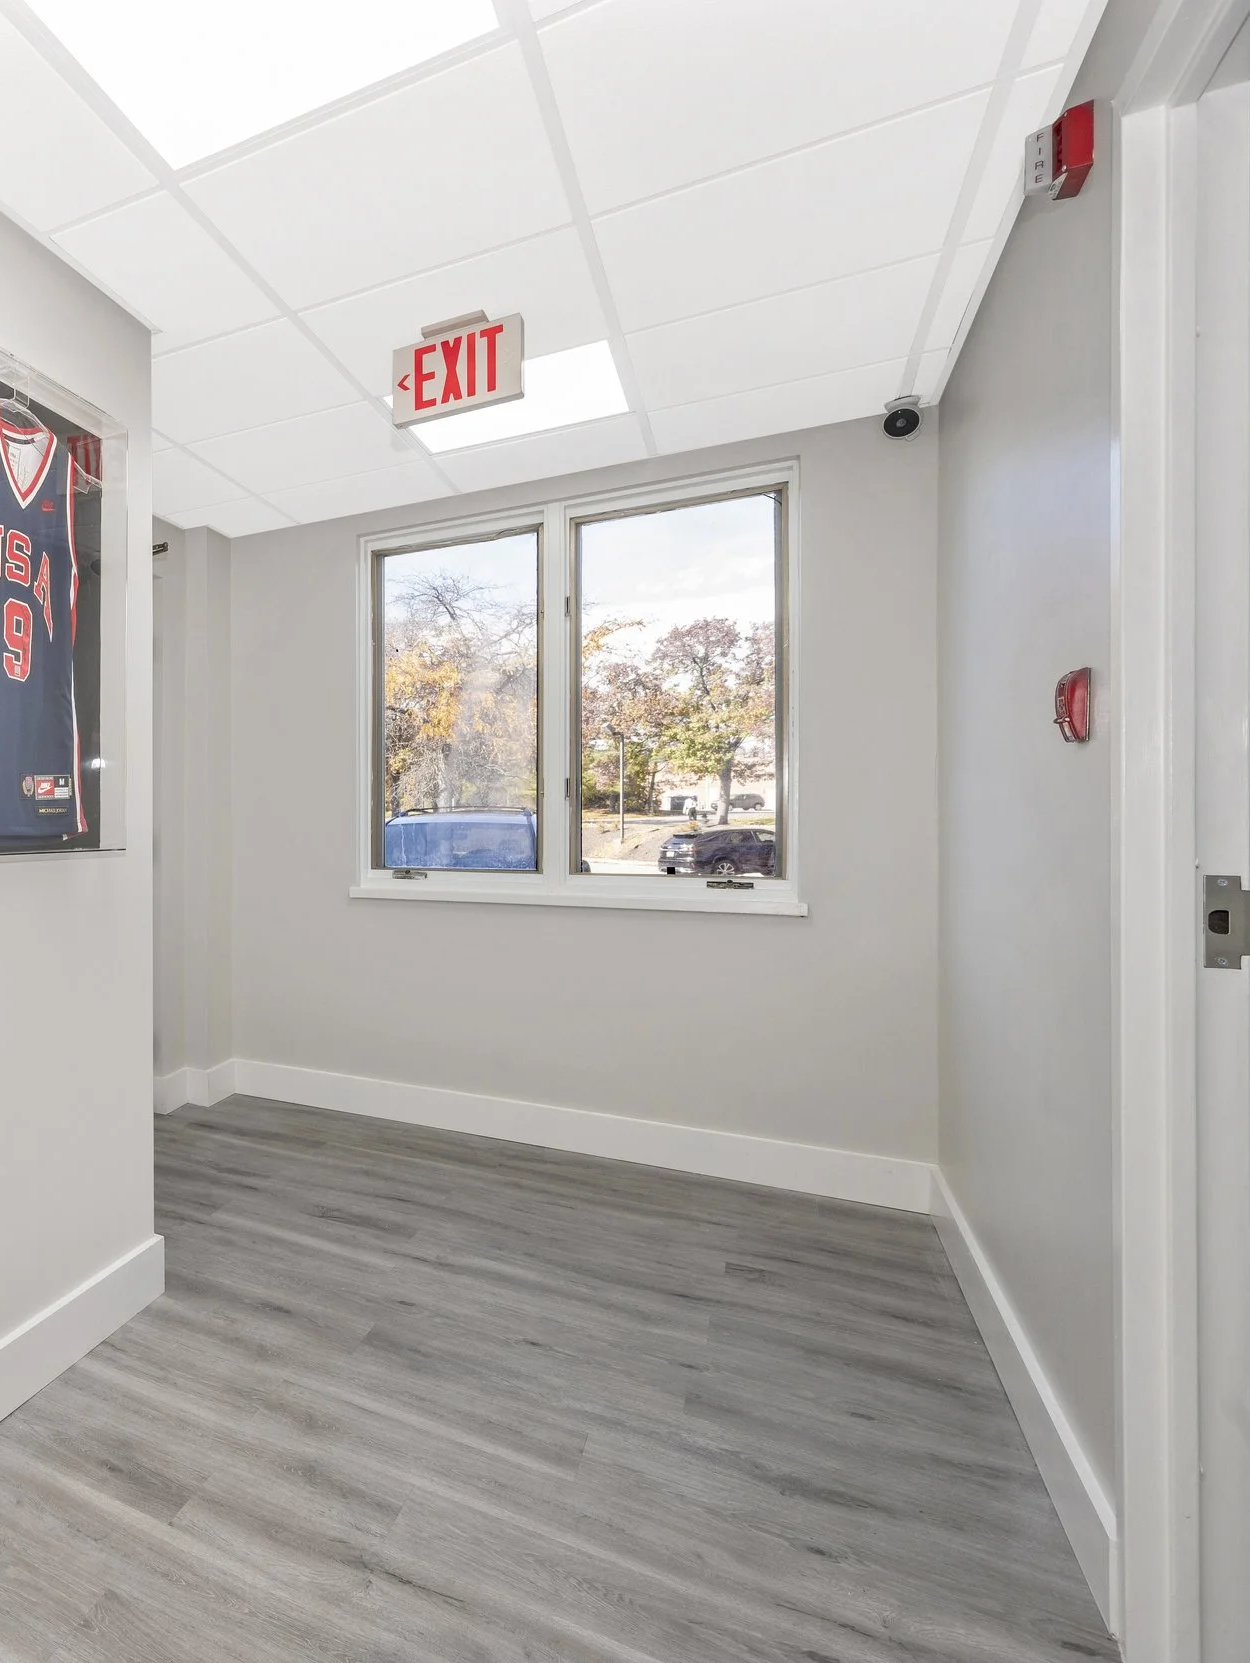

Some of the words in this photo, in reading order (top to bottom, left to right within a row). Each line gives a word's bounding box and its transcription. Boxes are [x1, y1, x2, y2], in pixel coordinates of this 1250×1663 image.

[1034, 132, 1045, 184] FIRE
[414, 324, 503, 411] EXIT
[3, 597, 33, 682] 9
